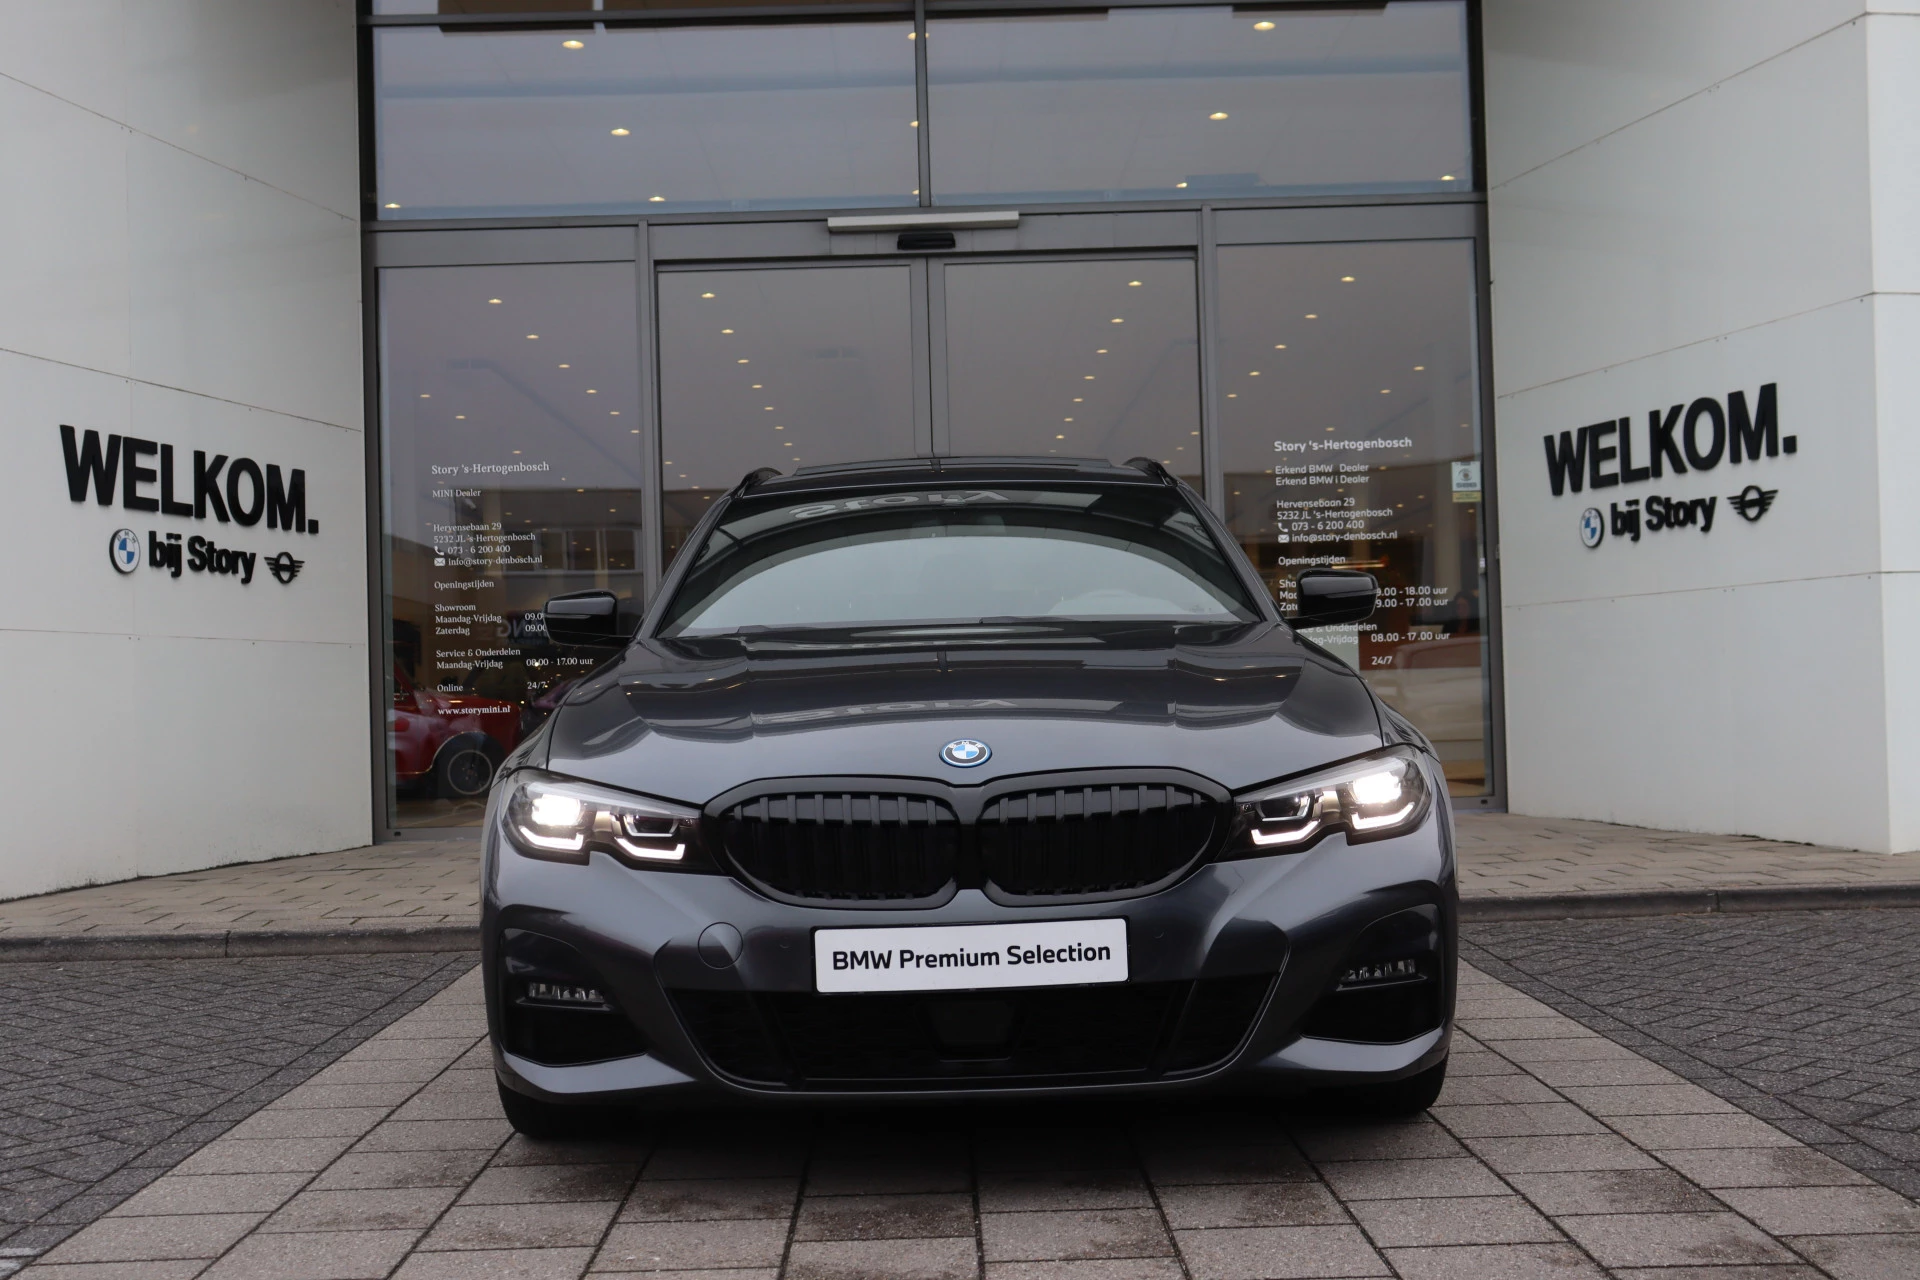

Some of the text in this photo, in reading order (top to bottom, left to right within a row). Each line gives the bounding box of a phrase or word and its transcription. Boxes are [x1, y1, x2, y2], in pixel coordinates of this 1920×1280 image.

[1544, 382, 1797, 496] WELKOM.
[1274, 441, 1306, 452] Story
[432, 465, 459, 476] Story
[1275, 463, 1369, 475] Erkend BMW Dealer
[60, 424, 319, 534] WELKOM.
[1276, 475, 1369, 486] Erkend BMW i Dealer
[432, 489, 481, 498] MINI Dealer
[1276, 498, 1355, 509] Hervensebaan 29
[1277, 508, 1393, 520] 5232 JL 's-Hertogenbosch
[1611, 495, 1717, 542] bij Story
[433, 524, 490, 533] Hervensebaan
[1291, 523, 1309, 531] 073
[1317, 522, 1324, 530] 6
[1325, 522, 1344, 530] 200
[1346, 520, 1365, 529] 400
[433, 536, 454, 544] 5232
[455, 535, 465, 543] JL
[1291, 531, 1398, 543] info@story-denbosch.nl
[447, 547, 463, 555] 073
[148, 530, 256, 584] bij Story
[448, 555, 543, 567] info@story-denbosch.nl
[1278, 555, 1346, 567] Openingstijden
[434, 580, 495, 590] Openingstijden
[1376, 587, 1397, 596] 9.00
[1405, 586, 1430, 595] 18.00
[1432, 587, 1448, 595] uur
[435, 604, 476, 612] Showroom
[1376, 599, 1397, 608] 9.00
[436, 614, 502, 623] Maandag-Vrijdag
[436, 627, 470, 635] Zaterdag
[1371, 634, 1399, 642] 08.00
[475, 648, 521, 656] Onderdelen
[436, 660, 503, 670] Maandag-Vrijdag
[556, 658, 578, 666] 17.00
[1371, 656, 1393, 665] 24/7
[437, 681, 546, 692] Online 24/7
[438, 705, 511, 716] www.storymini.nl
[832, 942, 1111, 971] BMW Premium Selection
